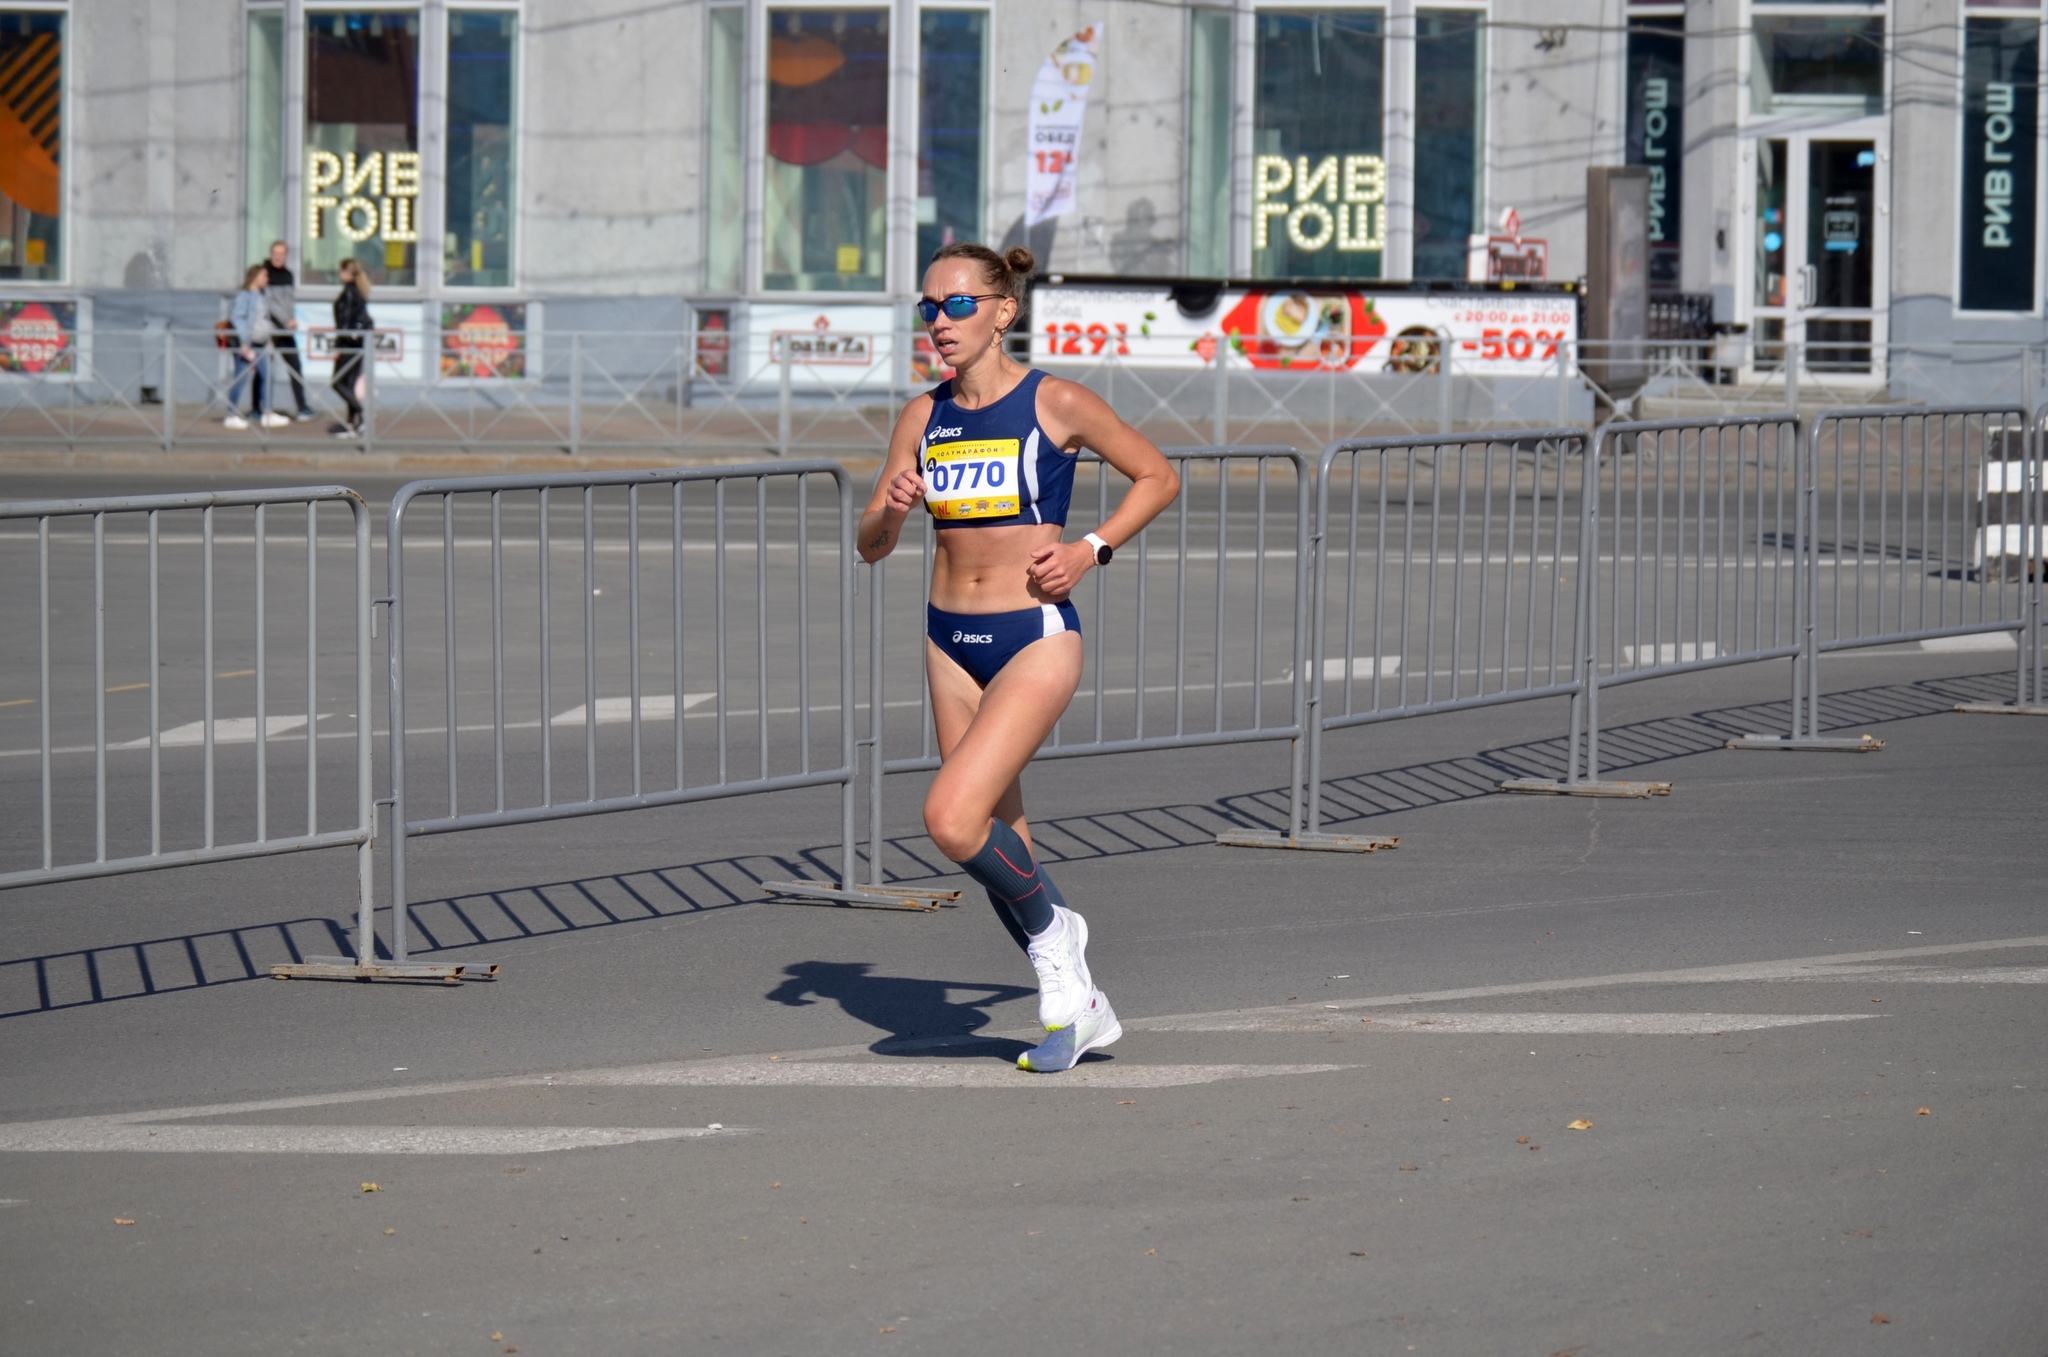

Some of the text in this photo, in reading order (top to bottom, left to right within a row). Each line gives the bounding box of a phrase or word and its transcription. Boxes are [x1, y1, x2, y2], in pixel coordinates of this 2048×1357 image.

[308, 151, 421, 197] РИВ
[1257, 154, 1387, 203] РИВ
[1645, 78, 1668, 242] РИВ ГОШ
[1983, 83, 2014, 247] РИВ ГОШ
[308, 196, 420, 242] ГОШ
[1255, 202, 1387, 251] ГОШ
[1465, 310, 1508, 323] 20:00
[1532, 312, 1571, 324] 21:00
[1461, 328, 1566, 361] -50%
[939, 427, 963, 438] asics
[933, 461, 1005, 492] 0770
[962, 633, 993, 643] asics
